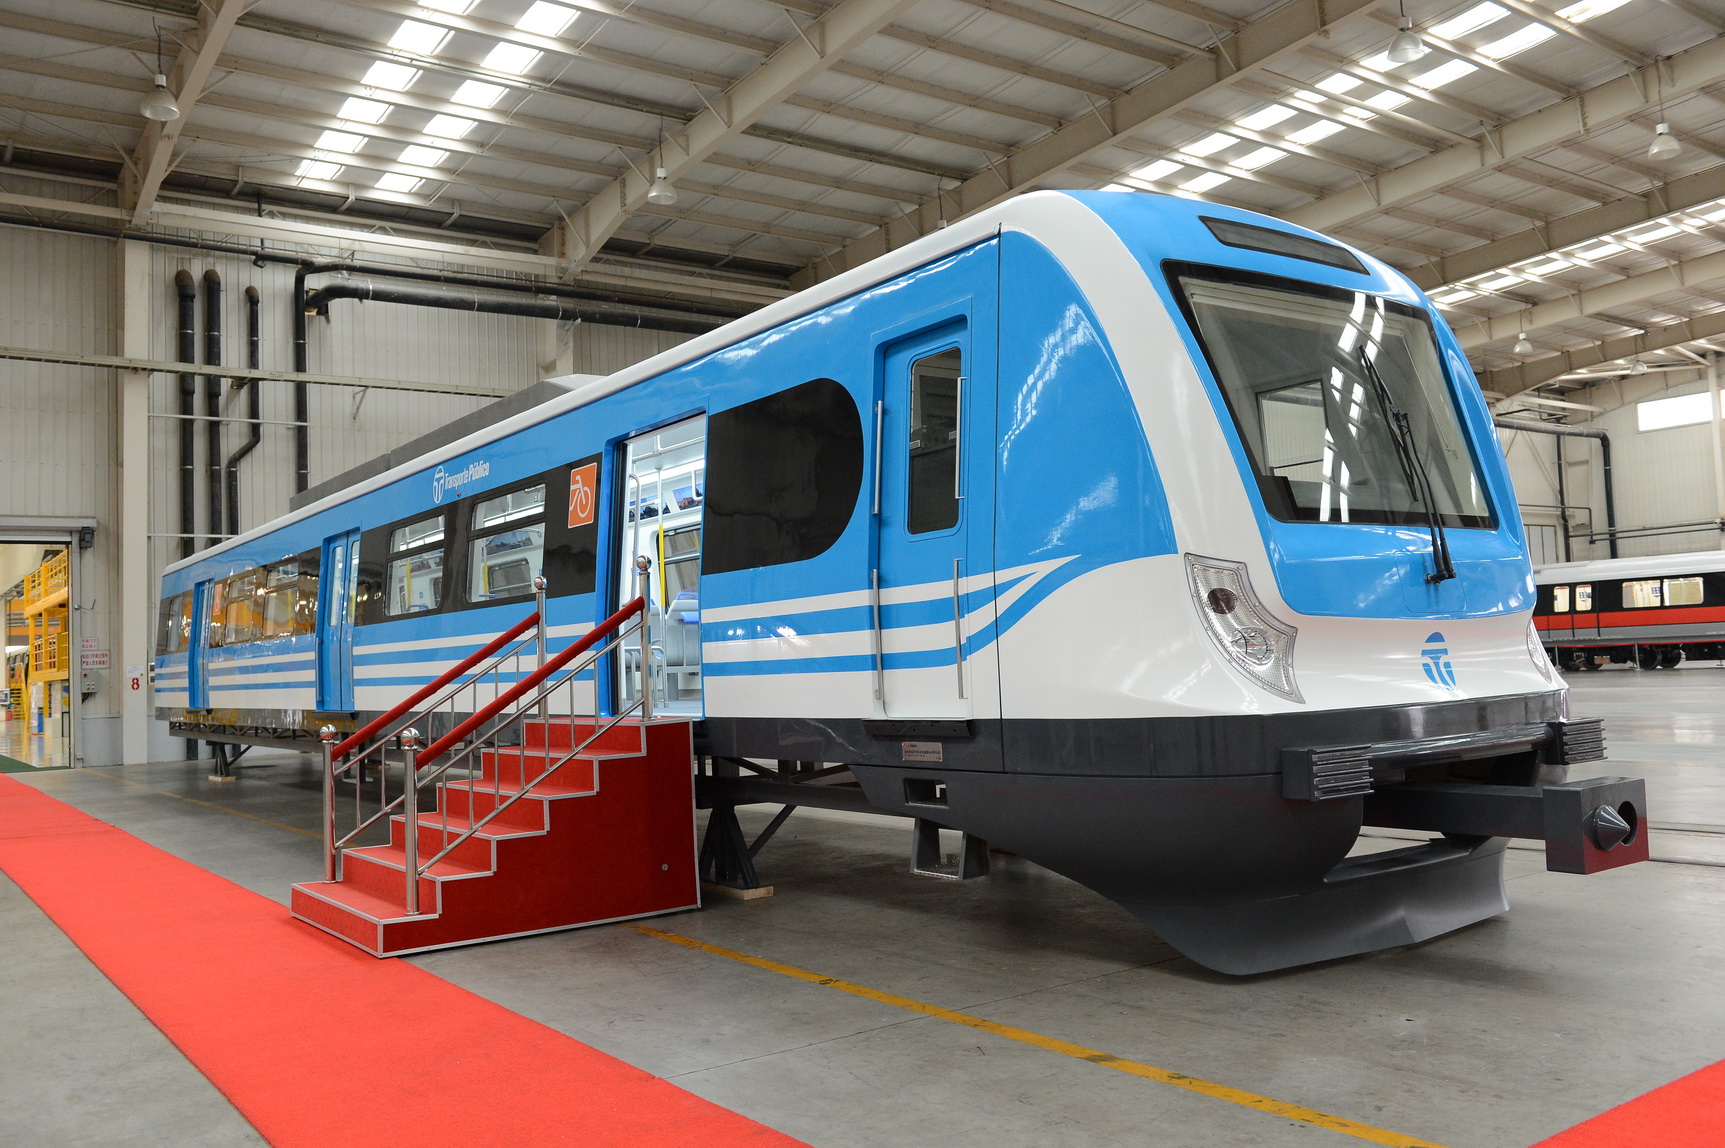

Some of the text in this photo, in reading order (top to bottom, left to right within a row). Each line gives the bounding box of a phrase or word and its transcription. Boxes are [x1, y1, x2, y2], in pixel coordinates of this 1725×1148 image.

[445, 460, 490, 490] Transporte Público
[131, 677, 140, 690] 8
